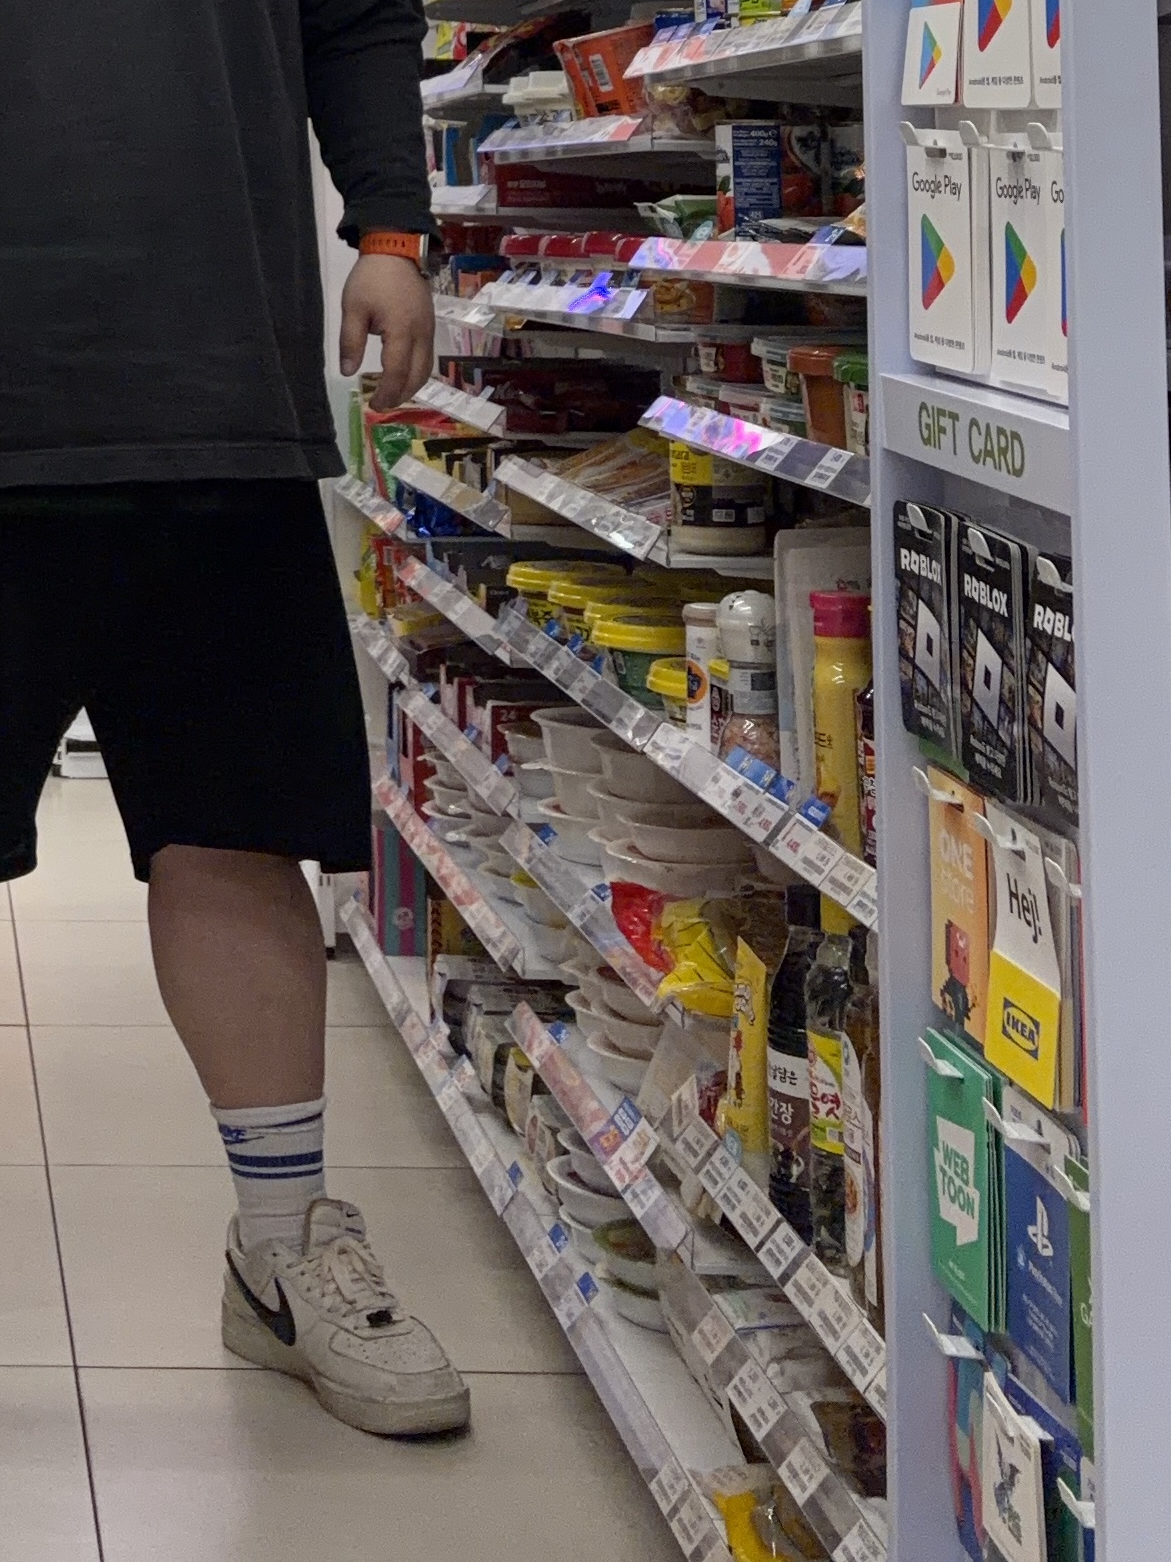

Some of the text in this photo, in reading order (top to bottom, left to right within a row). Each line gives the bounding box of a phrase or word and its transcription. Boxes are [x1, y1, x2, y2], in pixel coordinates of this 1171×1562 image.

[912, 171, 963, 202] Google Play
[995, 176, 1024, 206] Google
[1024, 177, 1041, 206] Play
[917, 401, 1026, 479] GIFT CARD
[899, 547, 943, 586] ROBLOX
[963, 573, 1009, 618] ROBLOX
[1033, 603, 1074, 642] ROBL
[938, 828, 974, 881] ONE
[1006, 872, 1043, 945] Hej!
[1005, 1010, 1037, 1046] IKEA
[941, 1140, 970, 1187] WEB
[939, 1164, 976, 1221] TOON
